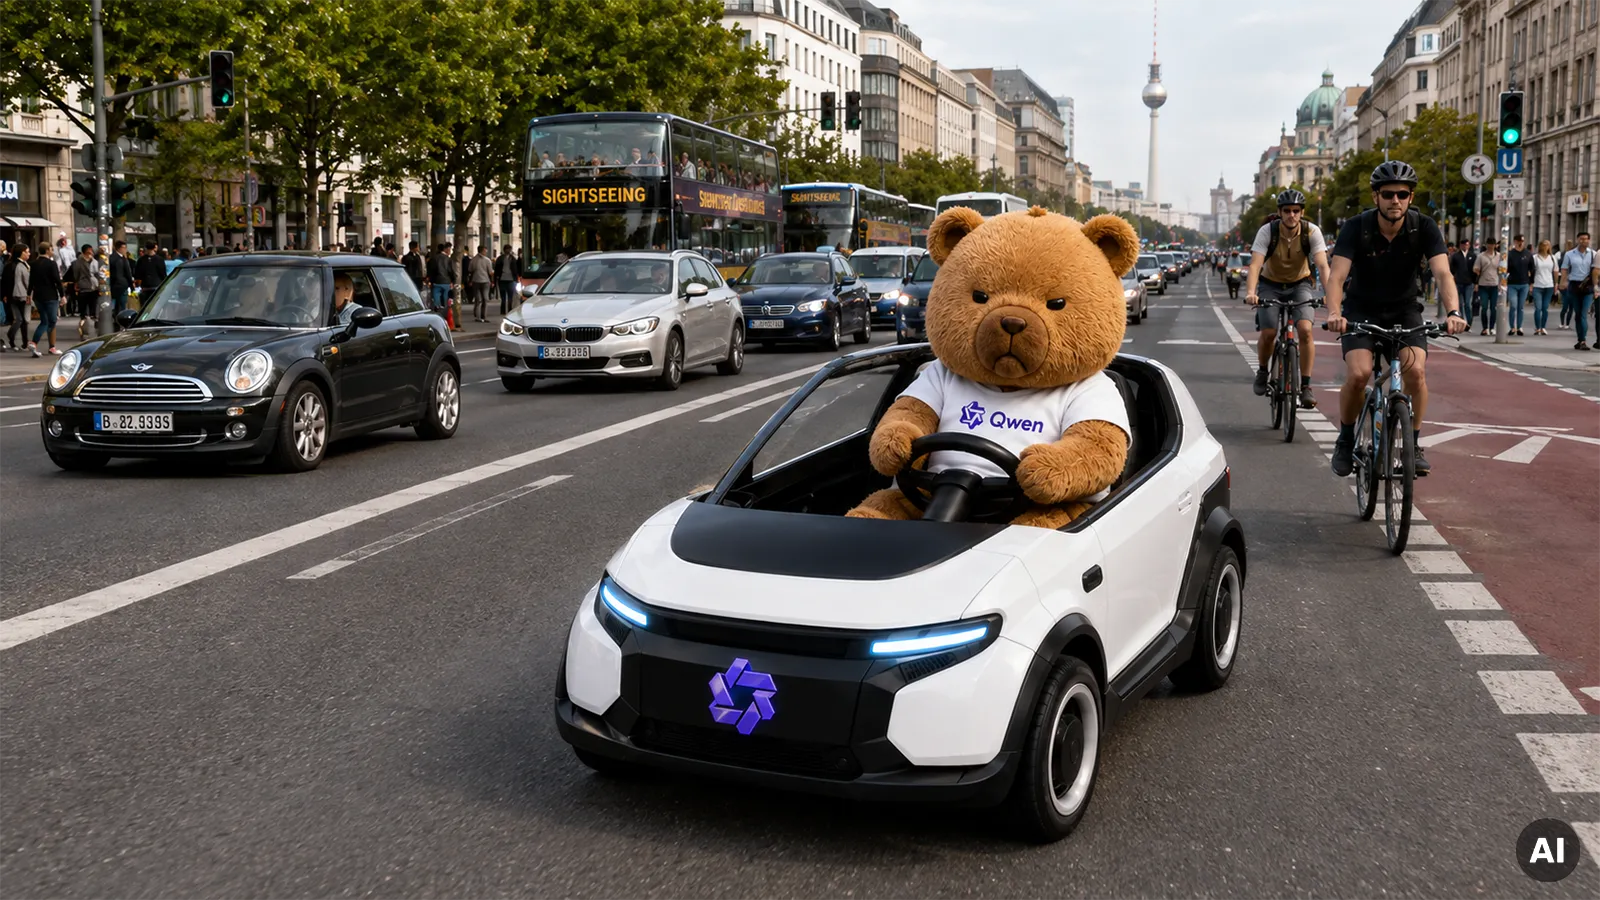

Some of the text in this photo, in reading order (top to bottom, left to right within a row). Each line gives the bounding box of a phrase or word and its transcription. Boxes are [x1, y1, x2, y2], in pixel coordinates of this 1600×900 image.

[1502, 152, 1518, 171] U
[542, 187, 646, 204] SIGHTSEEING
[990, 411, 1044, 433] Qwen
